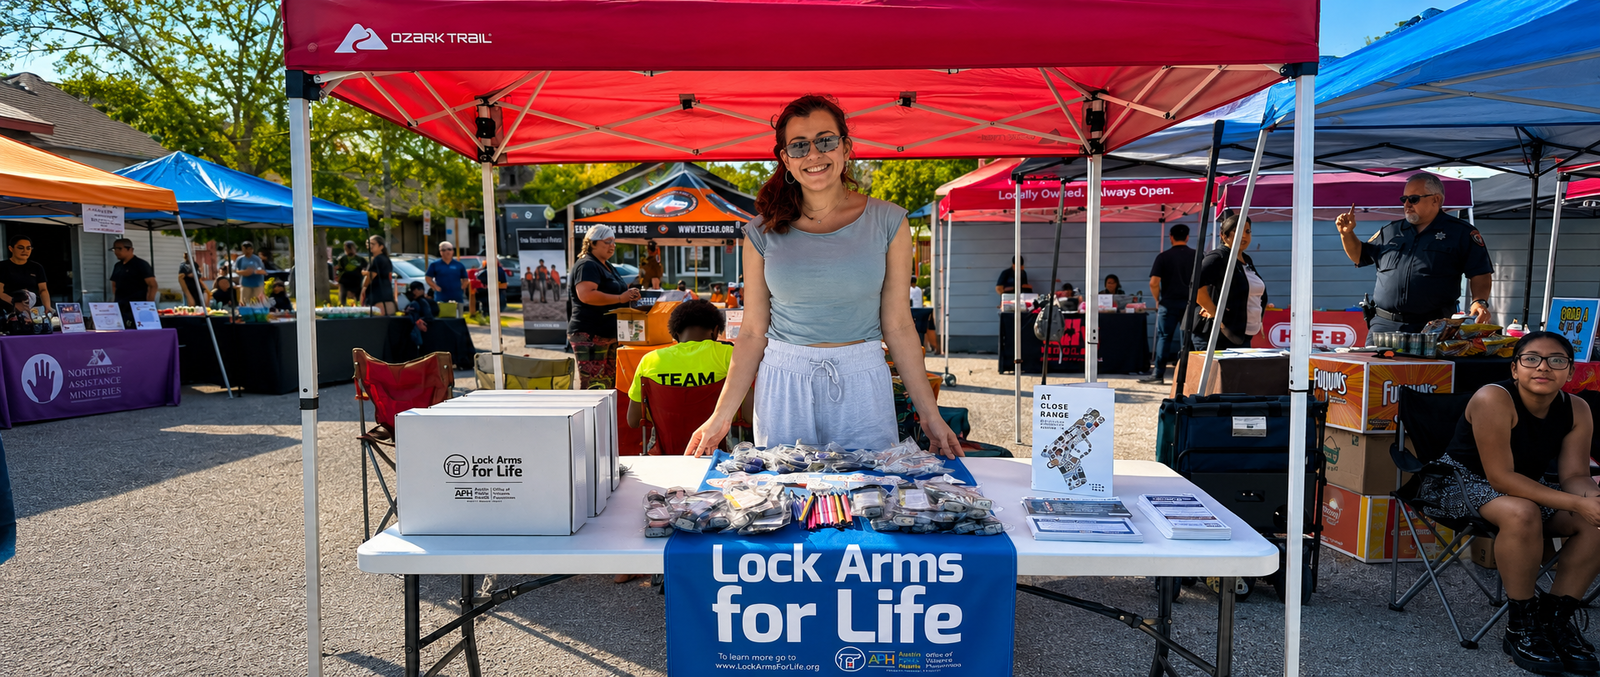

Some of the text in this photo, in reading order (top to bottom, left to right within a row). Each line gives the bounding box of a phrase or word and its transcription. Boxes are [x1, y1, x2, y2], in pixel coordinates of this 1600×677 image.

[391, 32, 445, 44] OZARK
[1041, 188, 1085, 199] Owed.
[1139, 186, 1174, 198] Open.
[1279, 328, 1347, 345] HE-B
[68, 376, 122, 389] ASSISTANCE
[657, 372, 715, 387] TEAM
[69, 387, 122, 400] MINISTRIES
[1040, 393, 1052, 401] AT
[1040, 402, 1069, 411] CLOSE
[1040, 410, 1070, 419] RANGE
[471, 455, 523, 465] Lock Arms
[471, 464, 523, 478] for Life
[455, 489, 473, 497] APH
[712, 543, 964, 583] Lock Arms
[711, 585, 963, 644] for Life
[717, 652, 728, 661] To
[729, 652, 750, 661] learn
[775, 654, 786, 663] go
[868, 653, 895, 665] APH
[715, 663, 820, 672] www.LockArmsForLife.org
